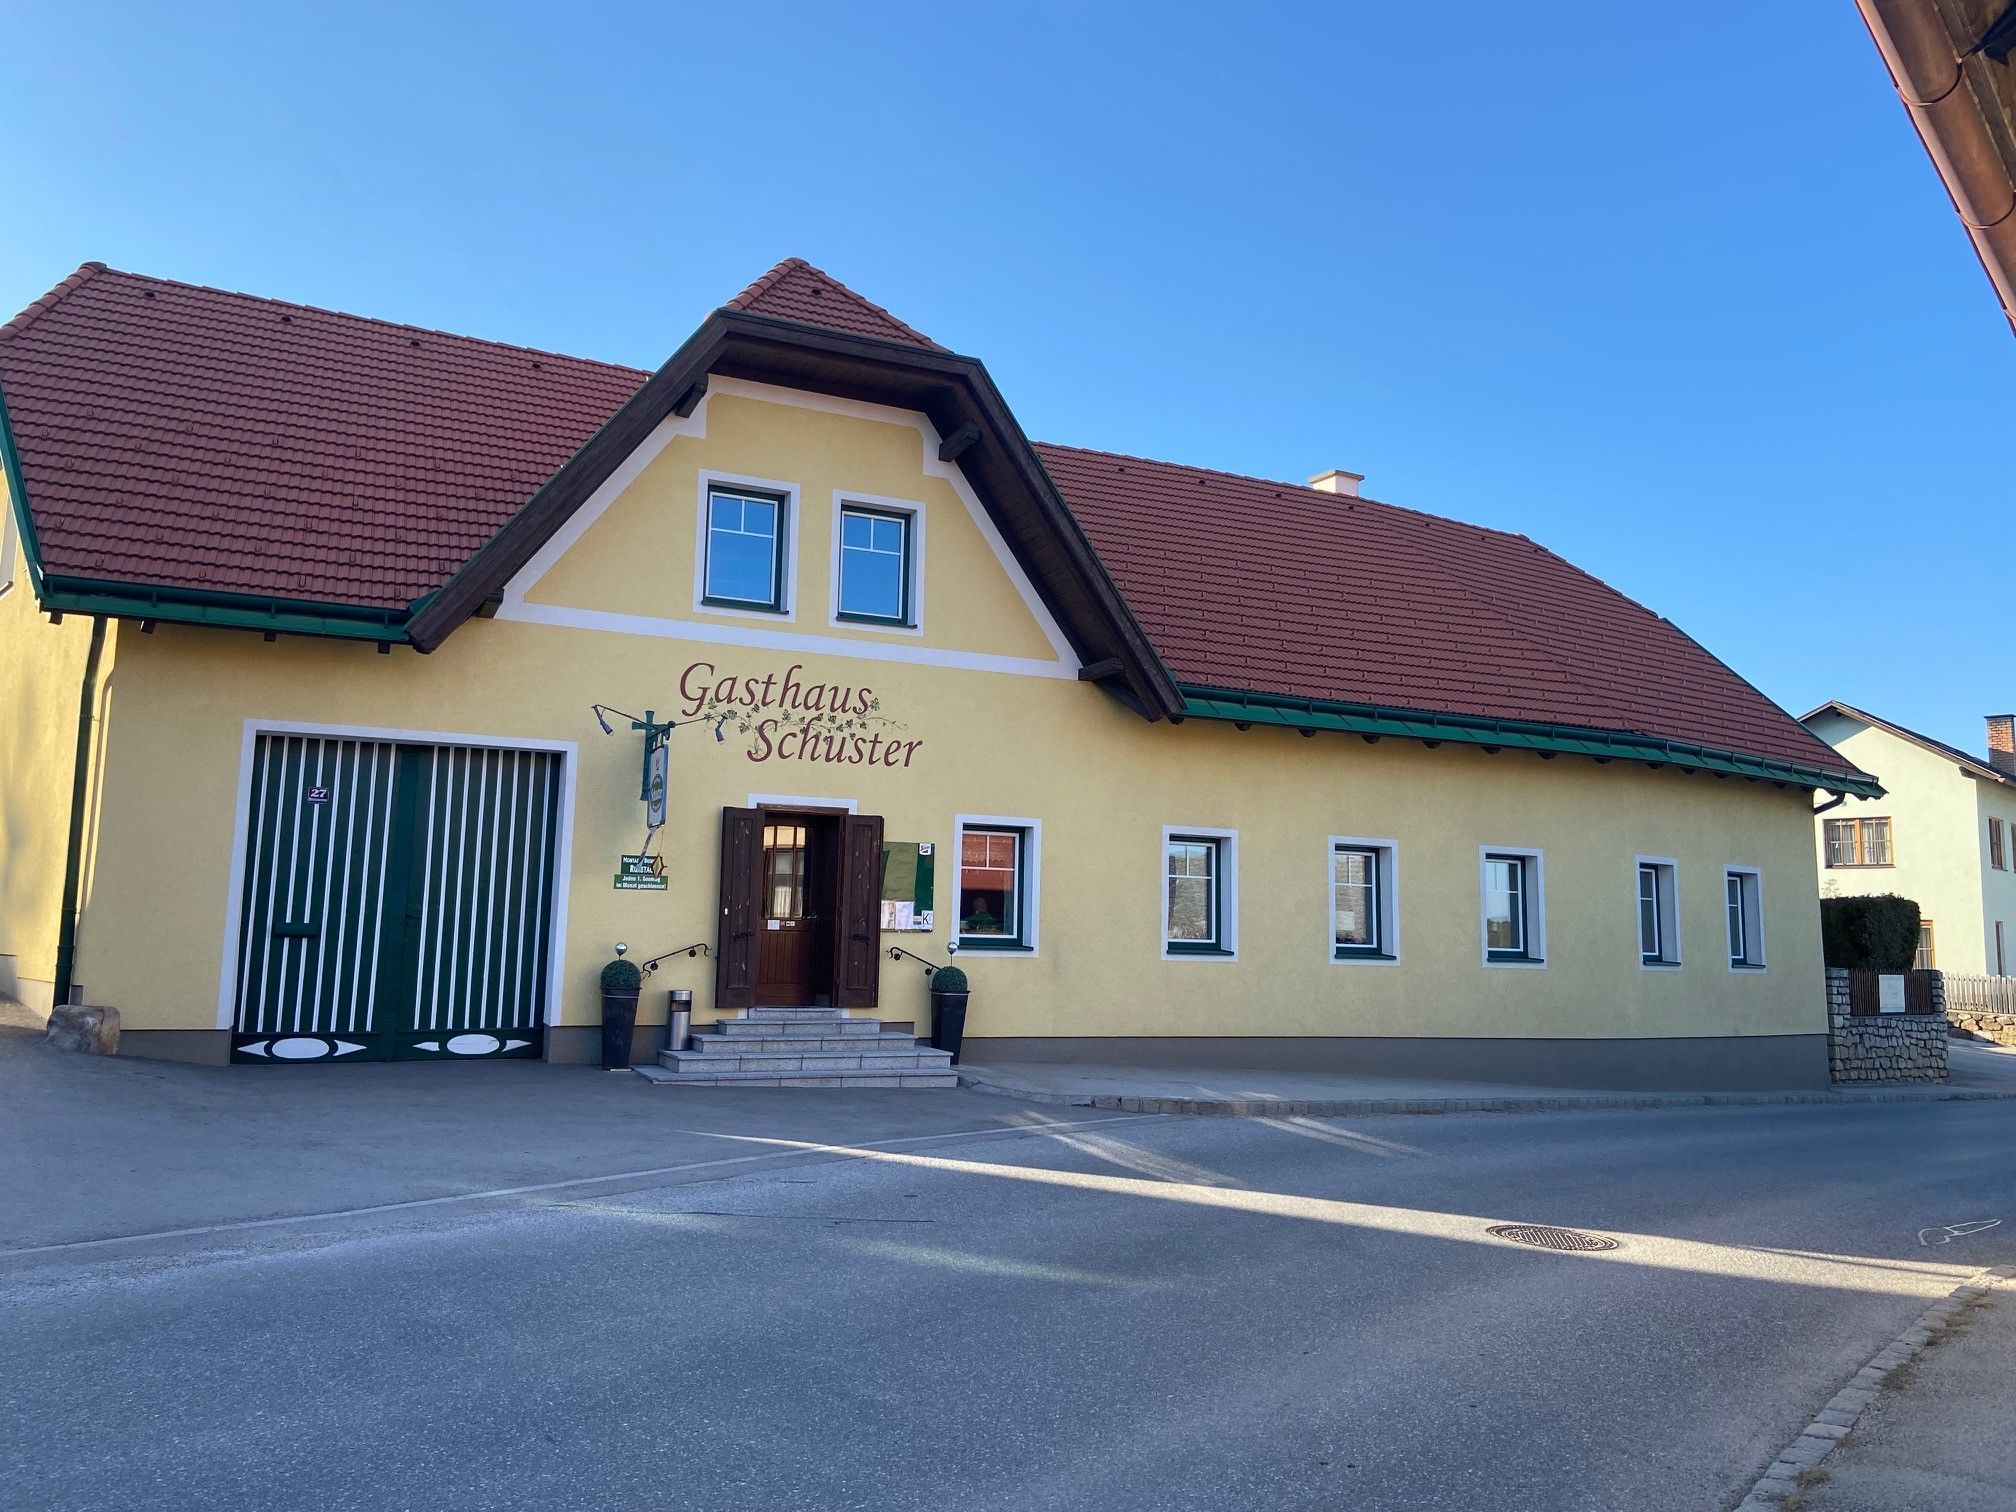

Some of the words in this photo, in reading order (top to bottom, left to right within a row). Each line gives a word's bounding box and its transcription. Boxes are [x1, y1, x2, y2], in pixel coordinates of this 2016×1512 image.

[679, 662, 872, 717] Gasthaus
[746, 717, 923, 767] Schuster
[310, 789, 327, 798] 27
